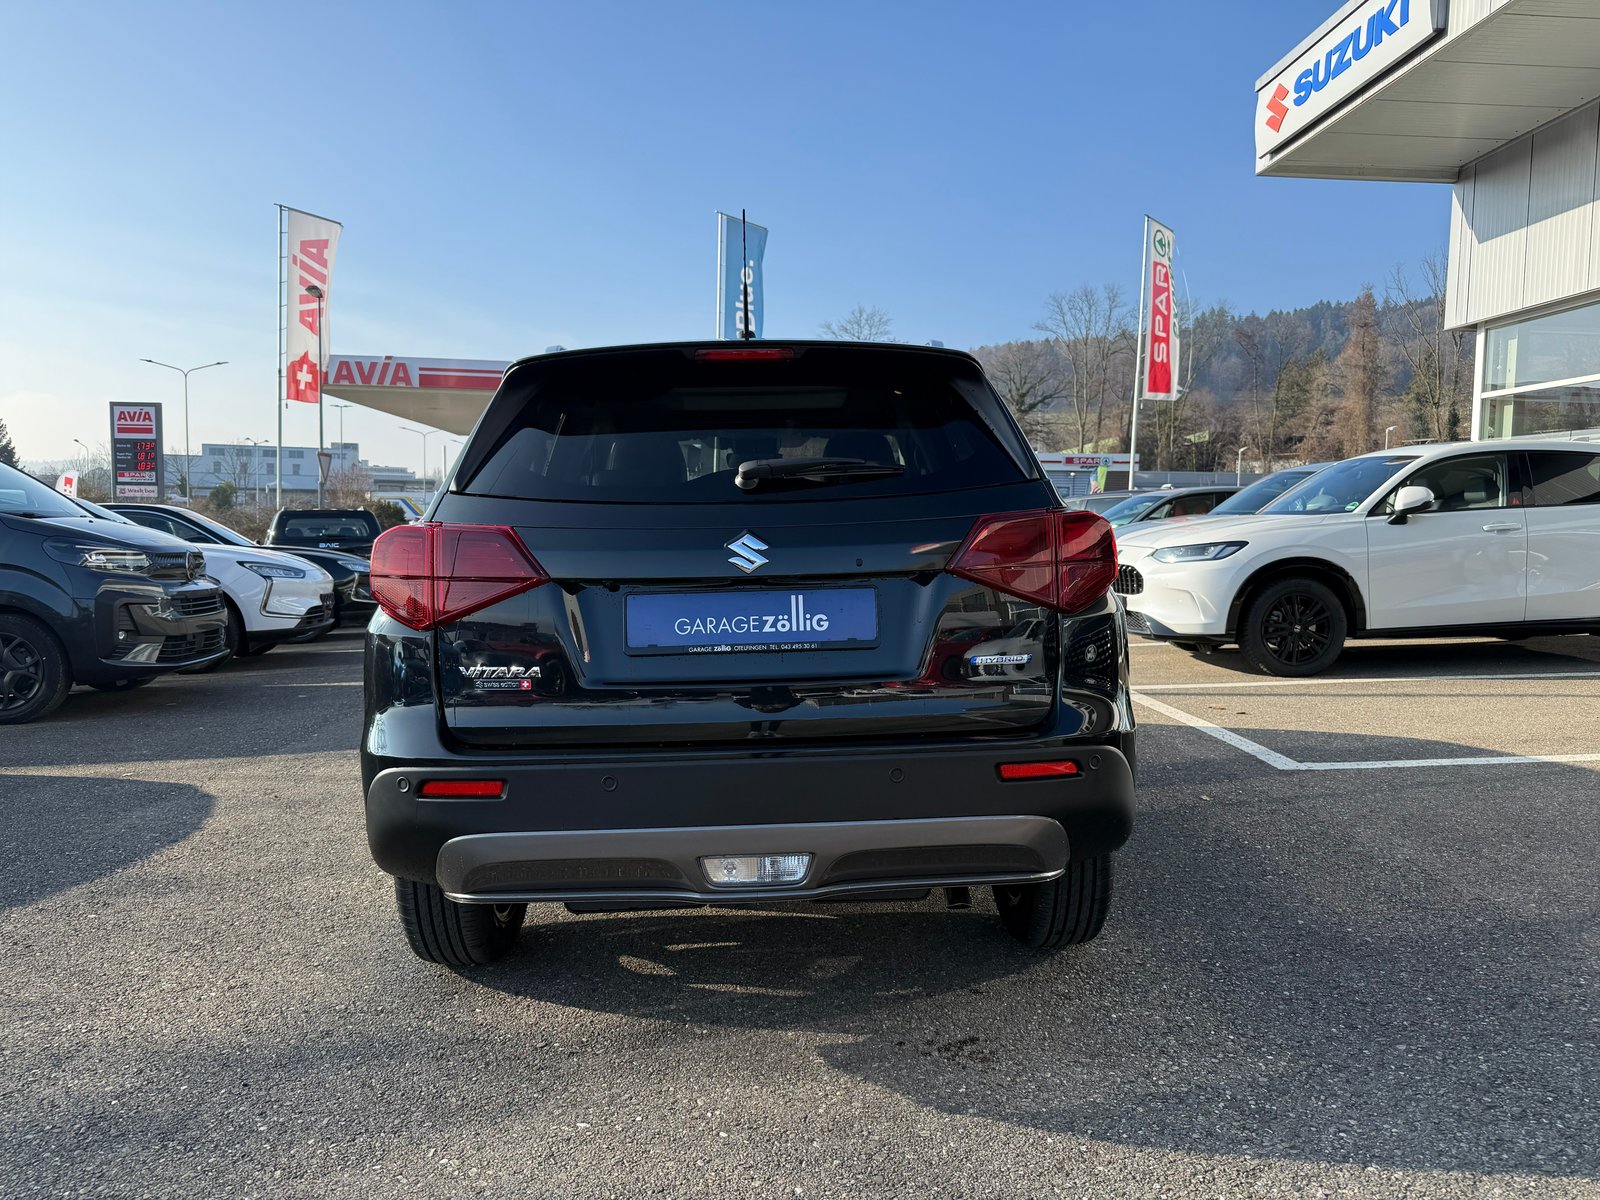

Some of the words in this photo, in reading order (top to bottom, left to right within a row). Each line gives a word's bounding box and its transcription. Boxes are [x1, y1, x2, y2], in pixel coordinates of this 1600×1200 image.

[1293, 0, 1409, 107] SUZUKI
[292, 238, 329, 336] AVIA
[1153, 264, 1169, 363] SPAR
[332, 355, 413, 386] AVIA
[117, 408, 153, 422] AVIA
[674, 615, 759, 635] GARAGE
[458, 664, 542, 679] VITARA
[980, 655, 1025, 664] HYBRID
